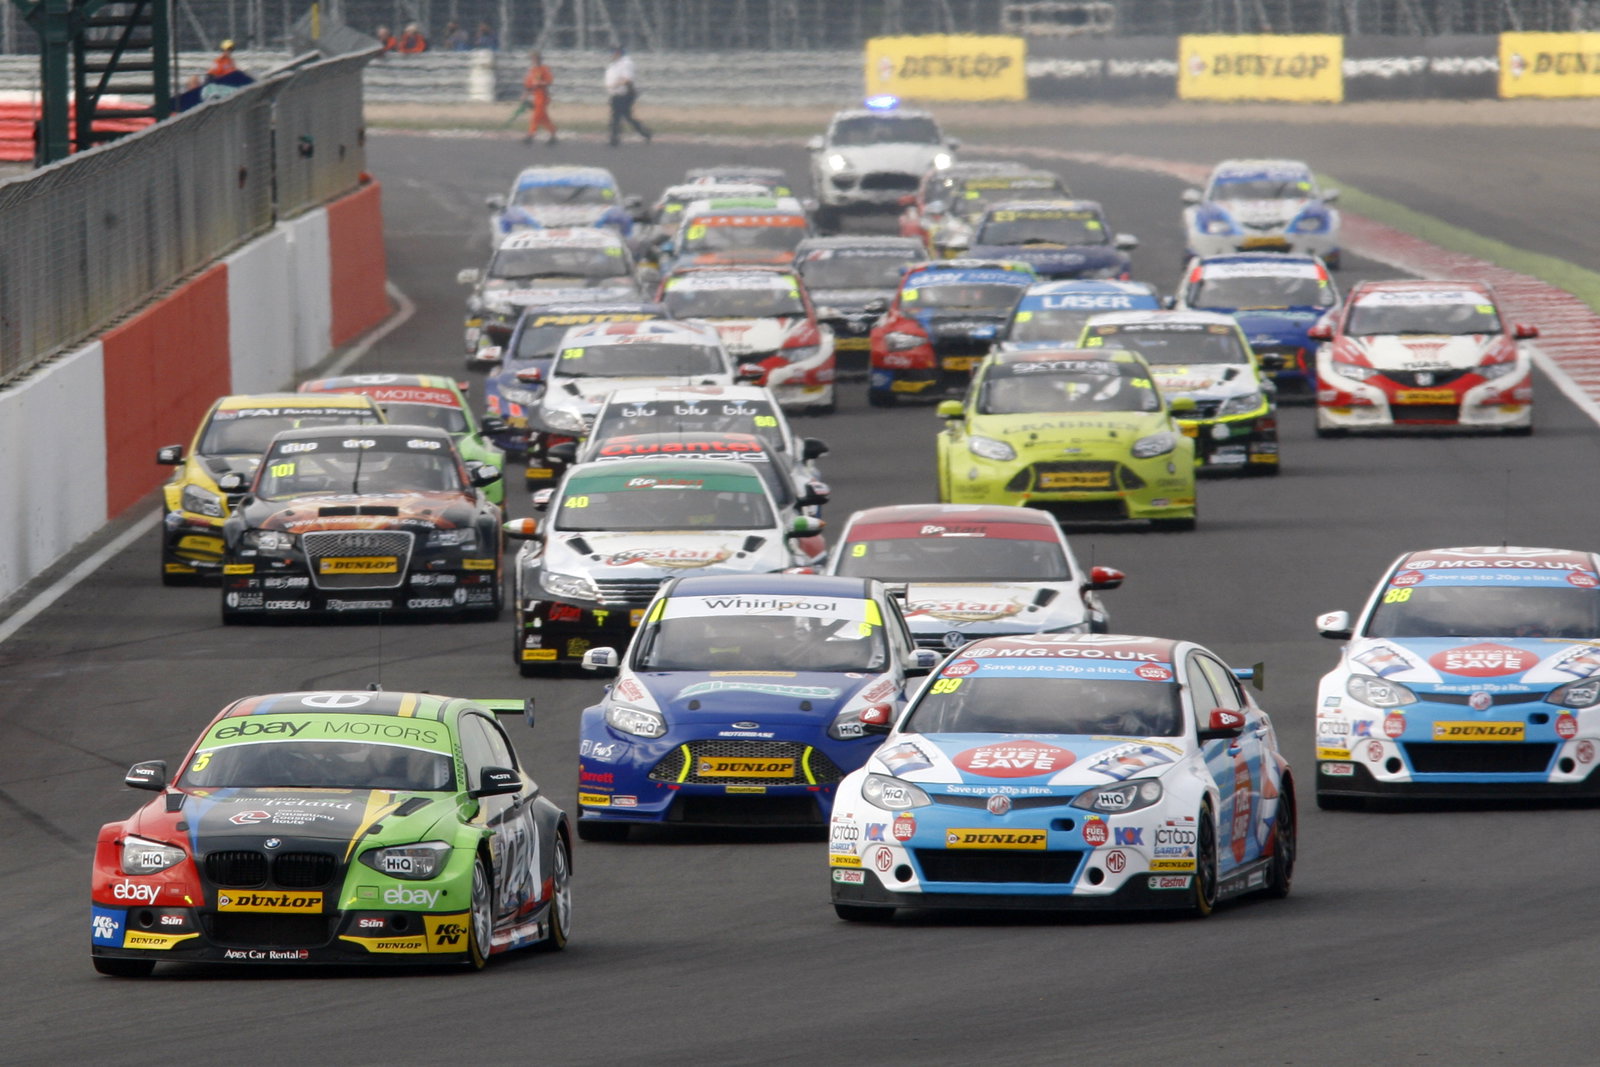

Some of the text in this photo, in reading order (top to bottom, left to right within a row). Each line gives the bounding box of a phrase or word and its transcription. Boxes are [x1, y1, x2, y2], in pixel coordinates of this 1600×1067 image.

[1213, 55, 1330, 77] DUNLOP
[1043, 296, 1133, 309] LASER
[375, 389, 453, 403] MOTORS
[622, 406, 657, 418] blu
[674, 404, 709, 416] blu
[722, 404, 757, 416] blu
[600, 441, 763, 455] Quantel
[271, 463, 296, 478] 101
[564, 496, 589, 508] 40
[852, 544, 867, 557] 9
[335, 561, 395, 569] DUNLOP
[1438, 560, 1588, 572] MG.CO.UK
[1384, 587, 1414, 603] 88
[265, 600, 311, 610] CORBEAU
[407, 598, 453, 608] CORBEAU
[705, 599, 837, 611] Whirlpool
[997, 647, 1160, 662] MG.CO.UK
[1446, 653, 1521, 661] FUEL
[982, 663, 1132, 676] Save up to 20p a litre.
[1445, 660, 1522, 669] SAVE
[930, 678, 963, 694] 99
[215, 720, 439, 744] ebay MOTORS
[635, 722, 657, 733] HiQ
[841, 725, 862, 735] HiQ
[1449, 726, 1523, 736] DUNLOP
[973, 751, 1057, 761] FUEL
[193, 753, 213, 772] 5
[716, 763, 793, 772] DUNLOP
[968, 759, 1056, 770] SAVE
[884, 789, 903, 799] HiQ
[946, 784, 971, 793] Save
[973, 786, 989, 796] up
[990, 785, 998, 794] to
[1000, 785, 1021, 796] 20p
[1029, 785, 1053, 795] litre.
[1101, 795, 1124, 805] HiQ
[963, 834, 1046, 844] DUNLOP
[142, 855, 163, 867] HiQ
[387, 859, 412, 871] HiQ
[836, 856, 861, 864] DUNLOP
[1107, 852, 1125, 872] MG
[1158, 861, 1194, 869] DUNLOP
[1160, 877, 1187, 888] Castrol
[113, 879, 161, 905] ebay
[384, 884, 441, 909] ebay
[235, 895, 322, 908] DUNLOP
[130, 937, 168, 945] DUNLOP
[376, 942, 422, 950] DUNLOP
[248, 949, 265, 960] Car
[270, 949, 299, 960] Rental
